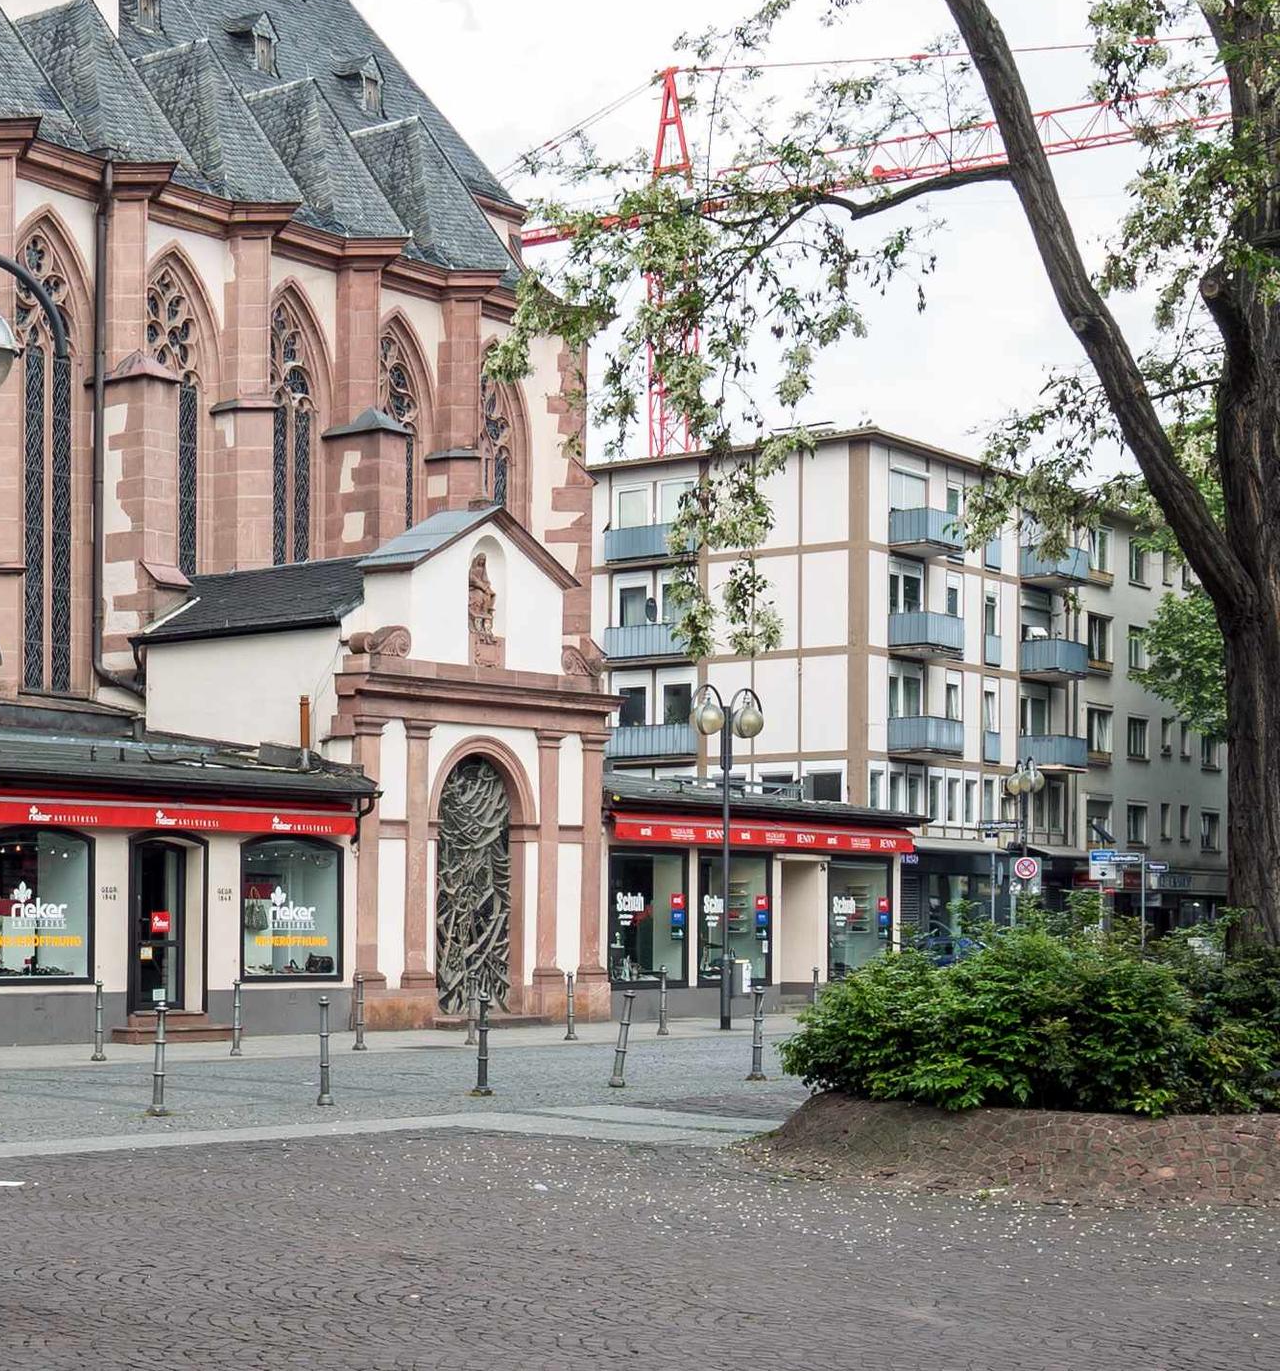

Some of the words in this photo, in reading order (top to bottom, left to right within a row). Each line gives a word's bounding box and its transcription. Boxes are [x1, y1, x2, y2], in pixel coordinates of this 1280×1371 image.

[28, 812, 52, 822] rieker
[705, 828, 725, 840] JENN
[11, 897, 68, 918] rieker
[269, 900, 316, 921] rieker
[616, 892, 644, 912] Schuh
[703, 895, 724, 914] Schu
[833, 896, 856, 914] Schuh
